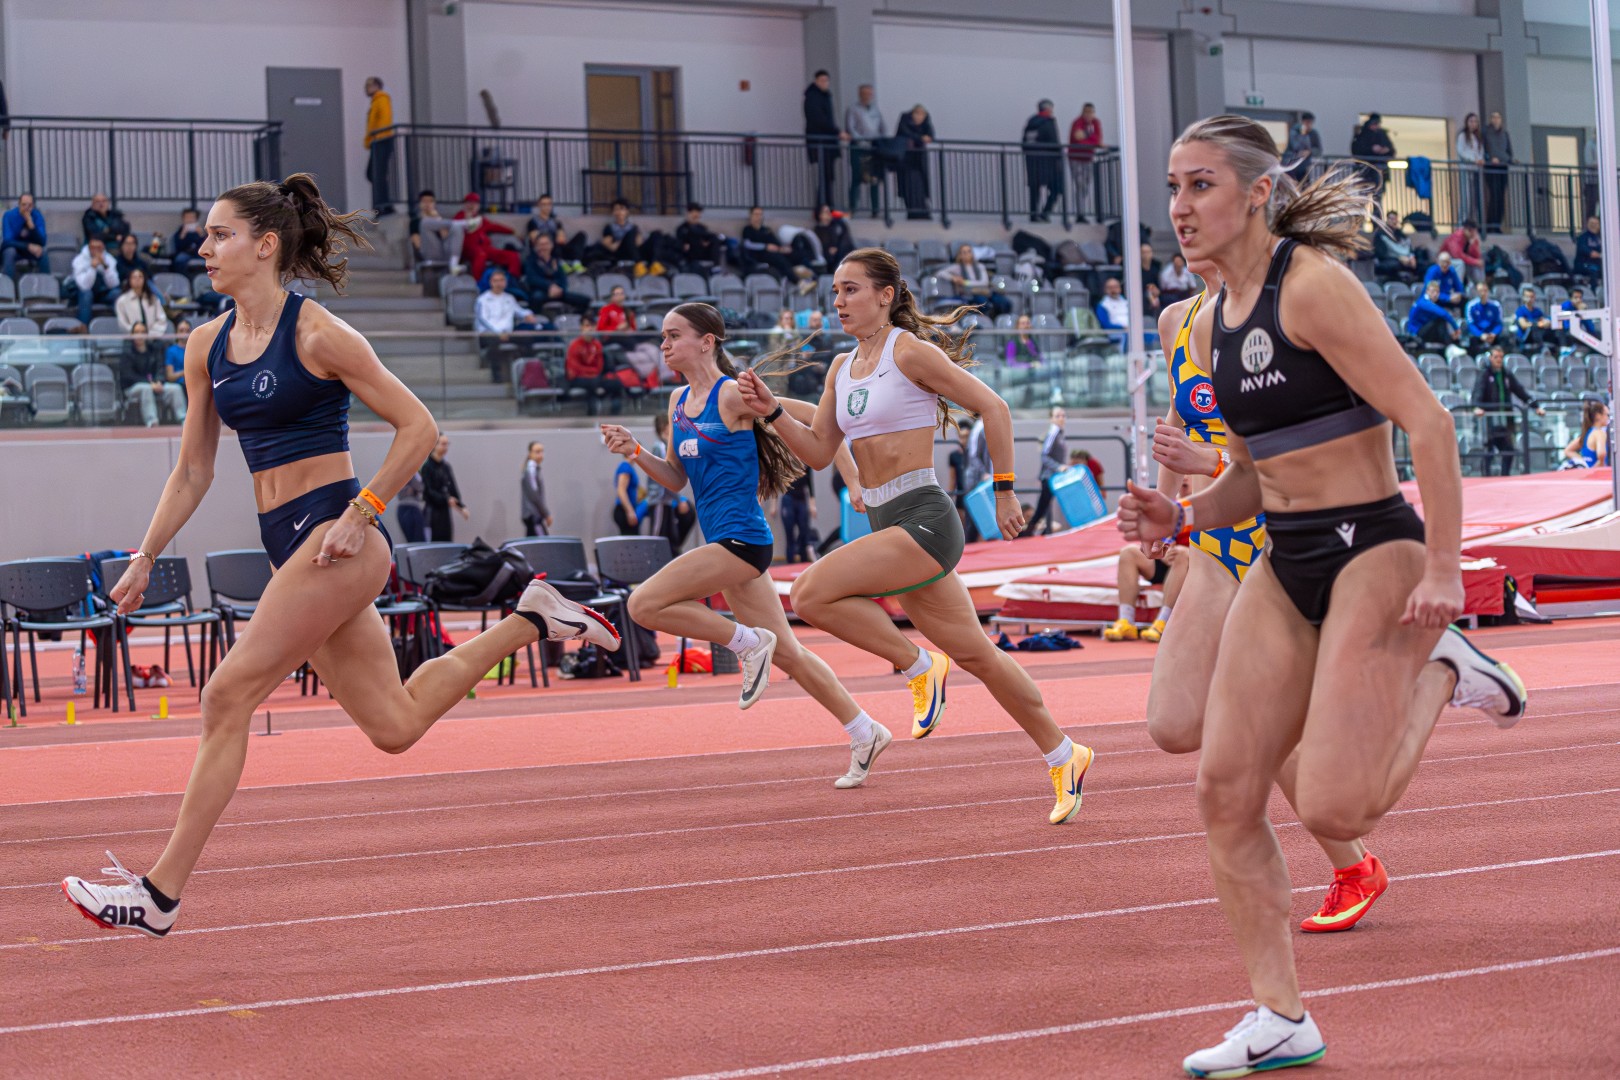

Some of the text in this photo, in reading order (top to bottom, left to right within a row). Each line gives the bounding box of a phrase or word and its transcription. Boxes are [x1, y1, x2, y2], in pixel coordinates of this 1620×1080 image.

[1241, 369, 1286, 392] MVM
[877, 472, 912, 502] NIKE
[98, 904, 146, 926] AIR
